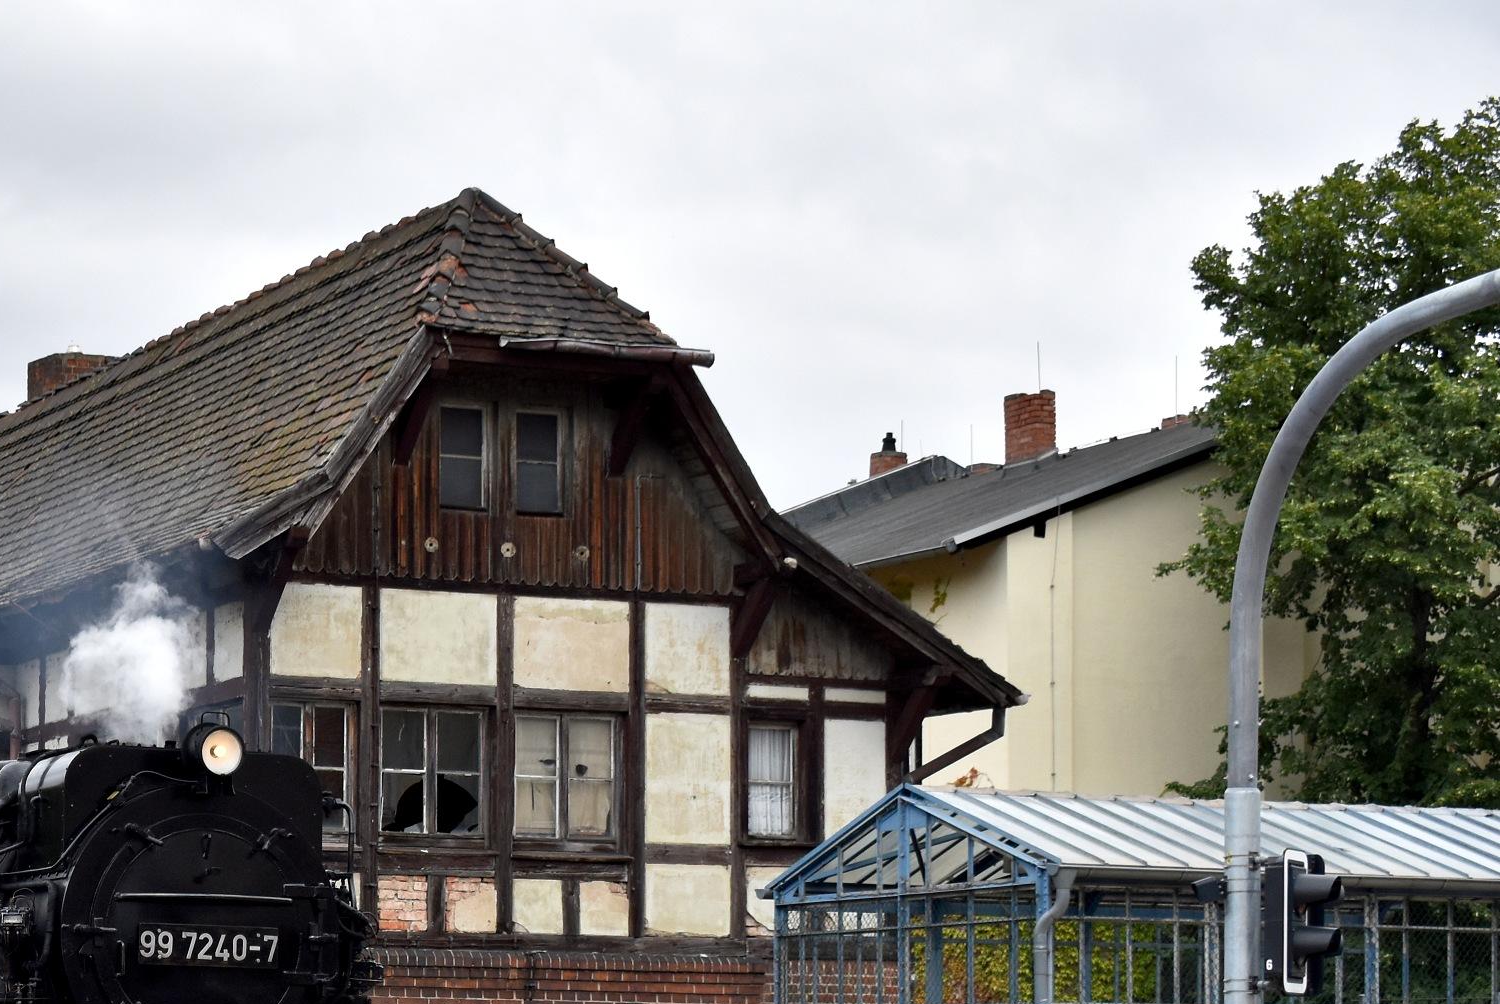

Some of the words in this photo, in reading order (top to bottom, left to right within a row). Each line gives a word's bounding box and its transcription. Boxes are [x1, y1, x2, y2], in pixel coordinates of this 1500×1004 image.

[140, 930, 174, 958] 99
[182, 931, 279, 962] 7240-7
[1265, 958, 1273, 971] 6
